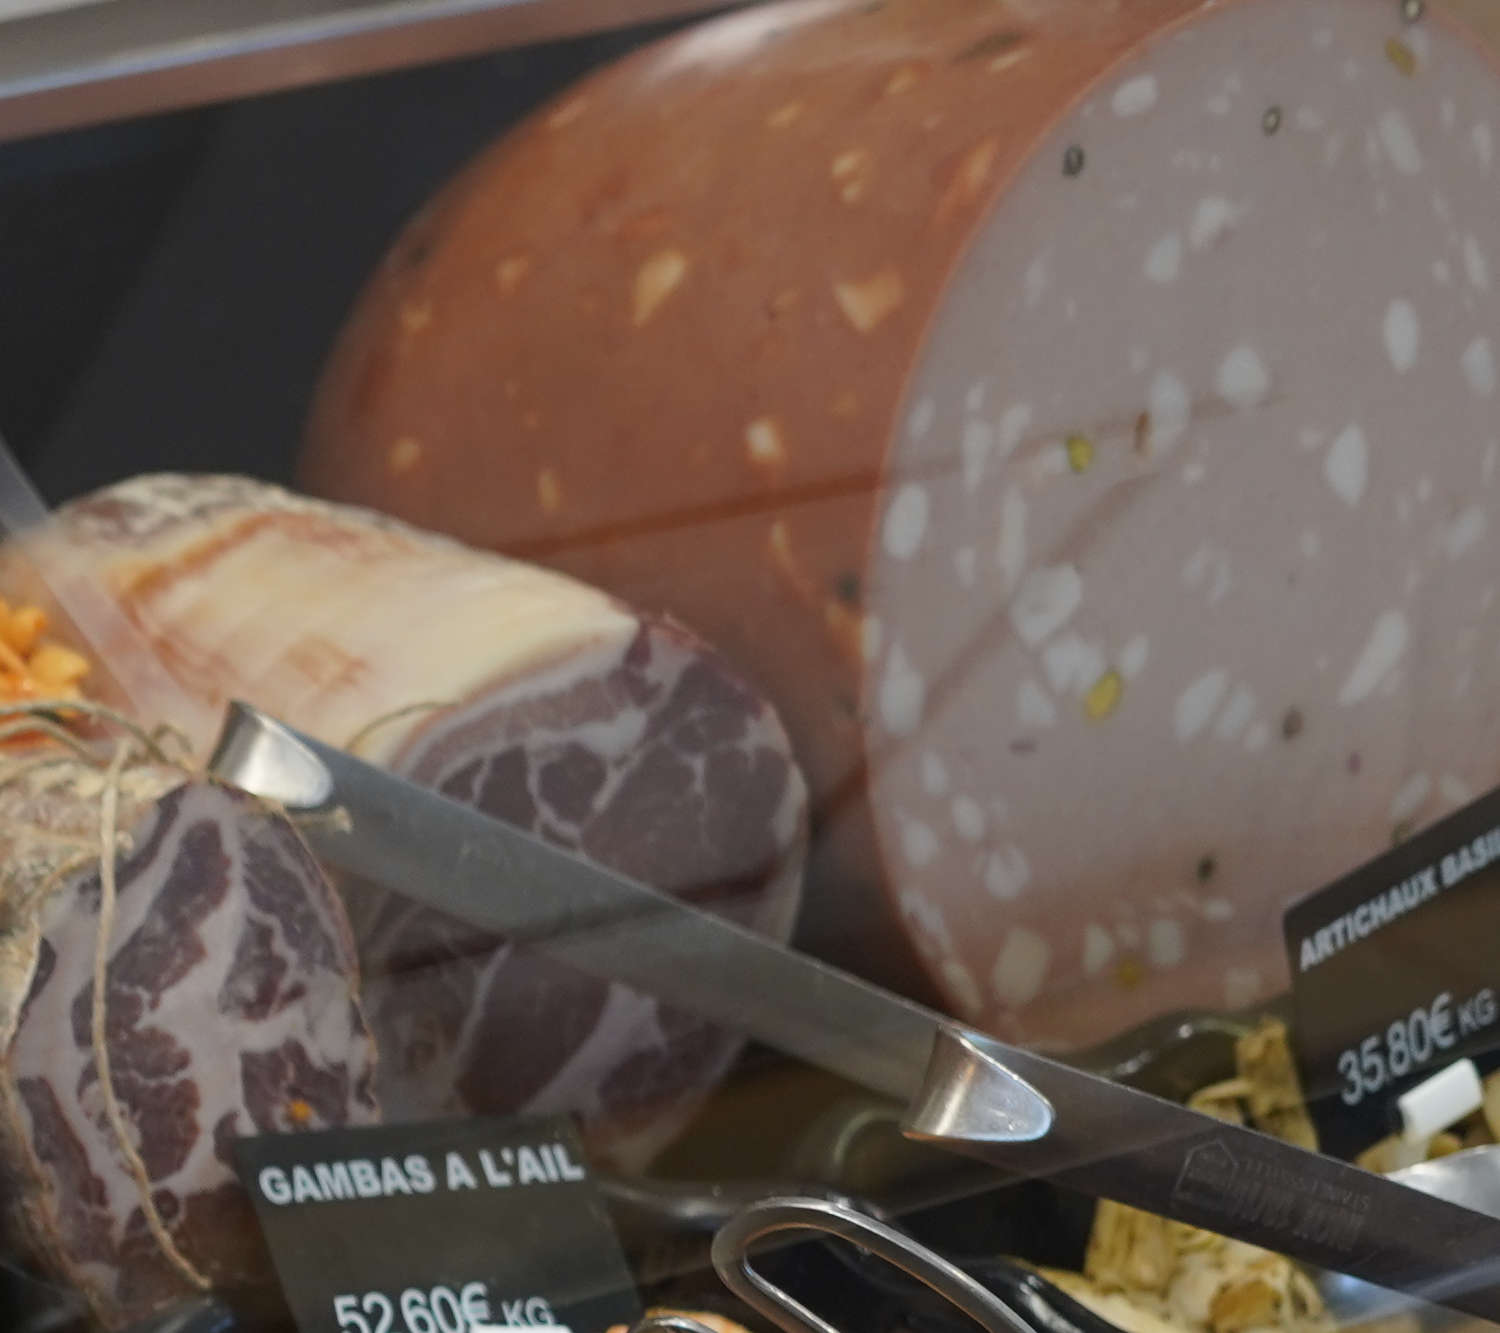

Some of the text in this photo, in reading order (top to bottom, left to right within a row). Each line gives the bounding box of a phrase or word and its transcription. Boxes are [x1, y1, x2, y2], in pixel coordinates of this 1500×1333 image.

[1300, 864, 1438, 972] ARTICHAUX
[1457, 987, 1497, 1038] KG
[259, 1143, 585, 1204] GAMBAS A L'AIL
[501, 1297, 558, 1326] KG
